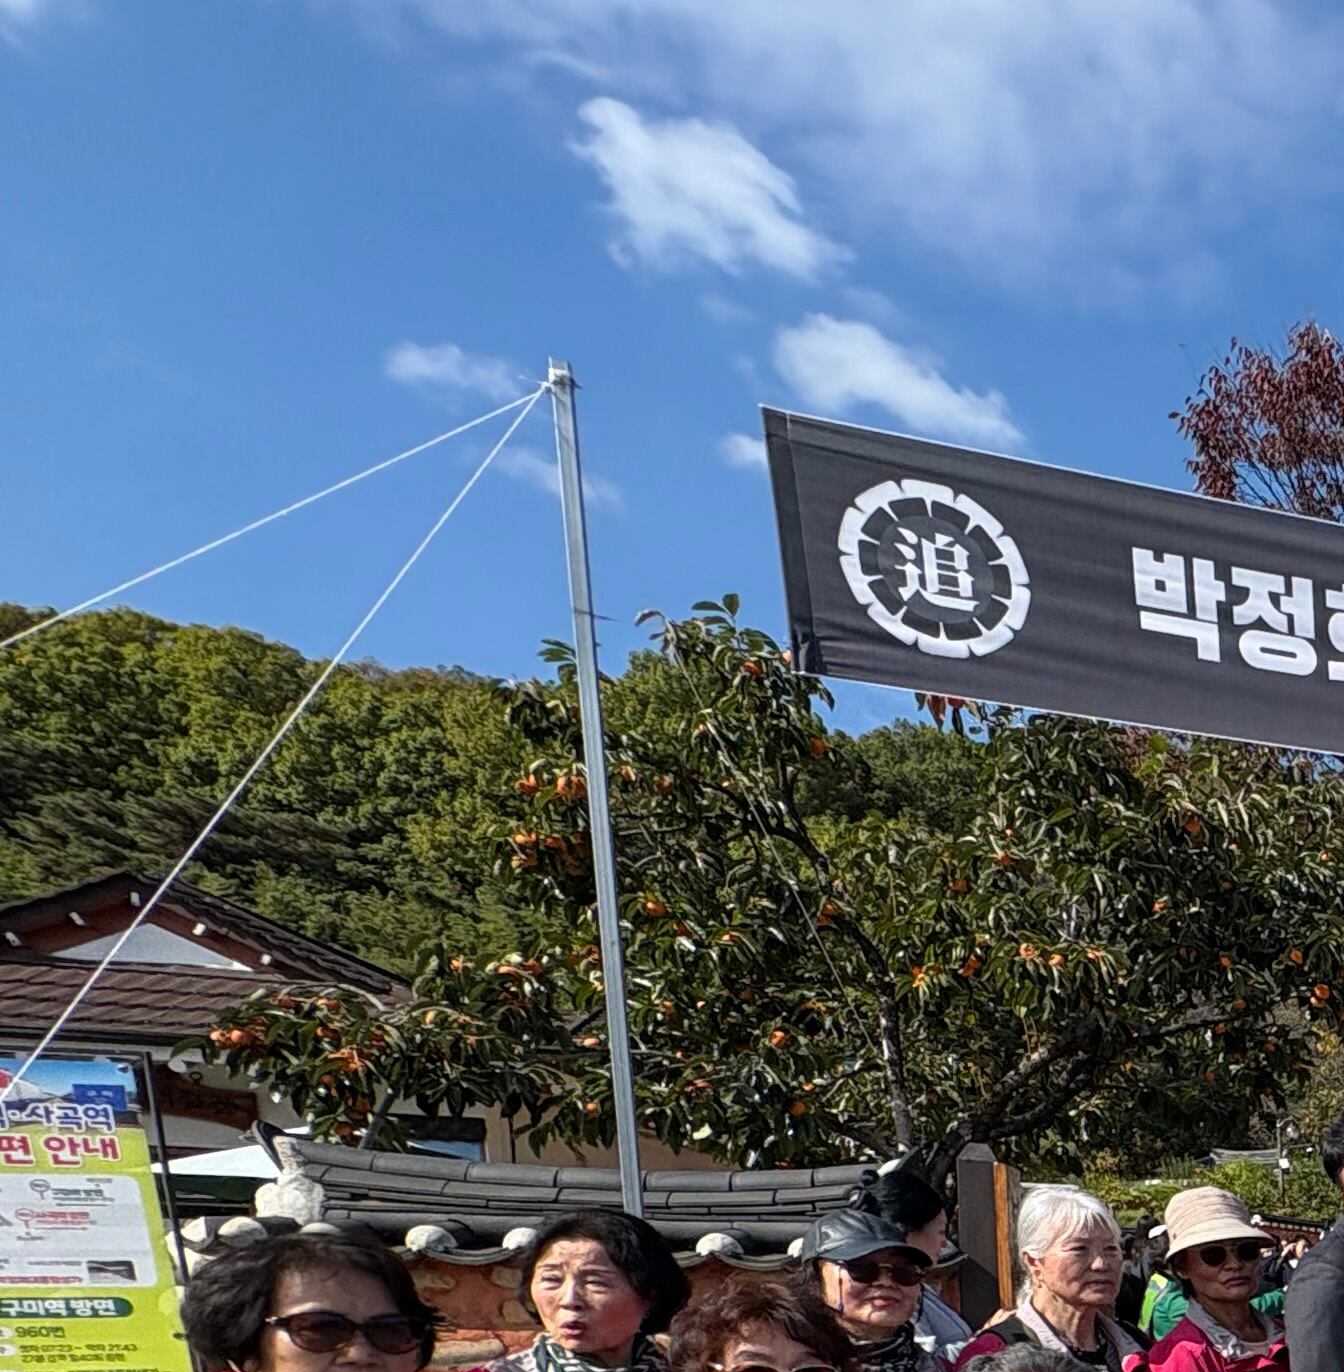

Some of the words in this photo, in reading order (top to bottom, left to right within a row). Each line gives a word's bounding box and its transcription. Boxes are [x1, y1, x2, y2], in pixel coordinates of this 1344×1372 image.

[894, 527, 976, 612] 追
[43, 1136, 120, 1165] 안내
[1, 1299, 67, 1316] 구미역
[70, 1299, 118, 1316] 방면
[15, 1326, 66, 1339] 960번
